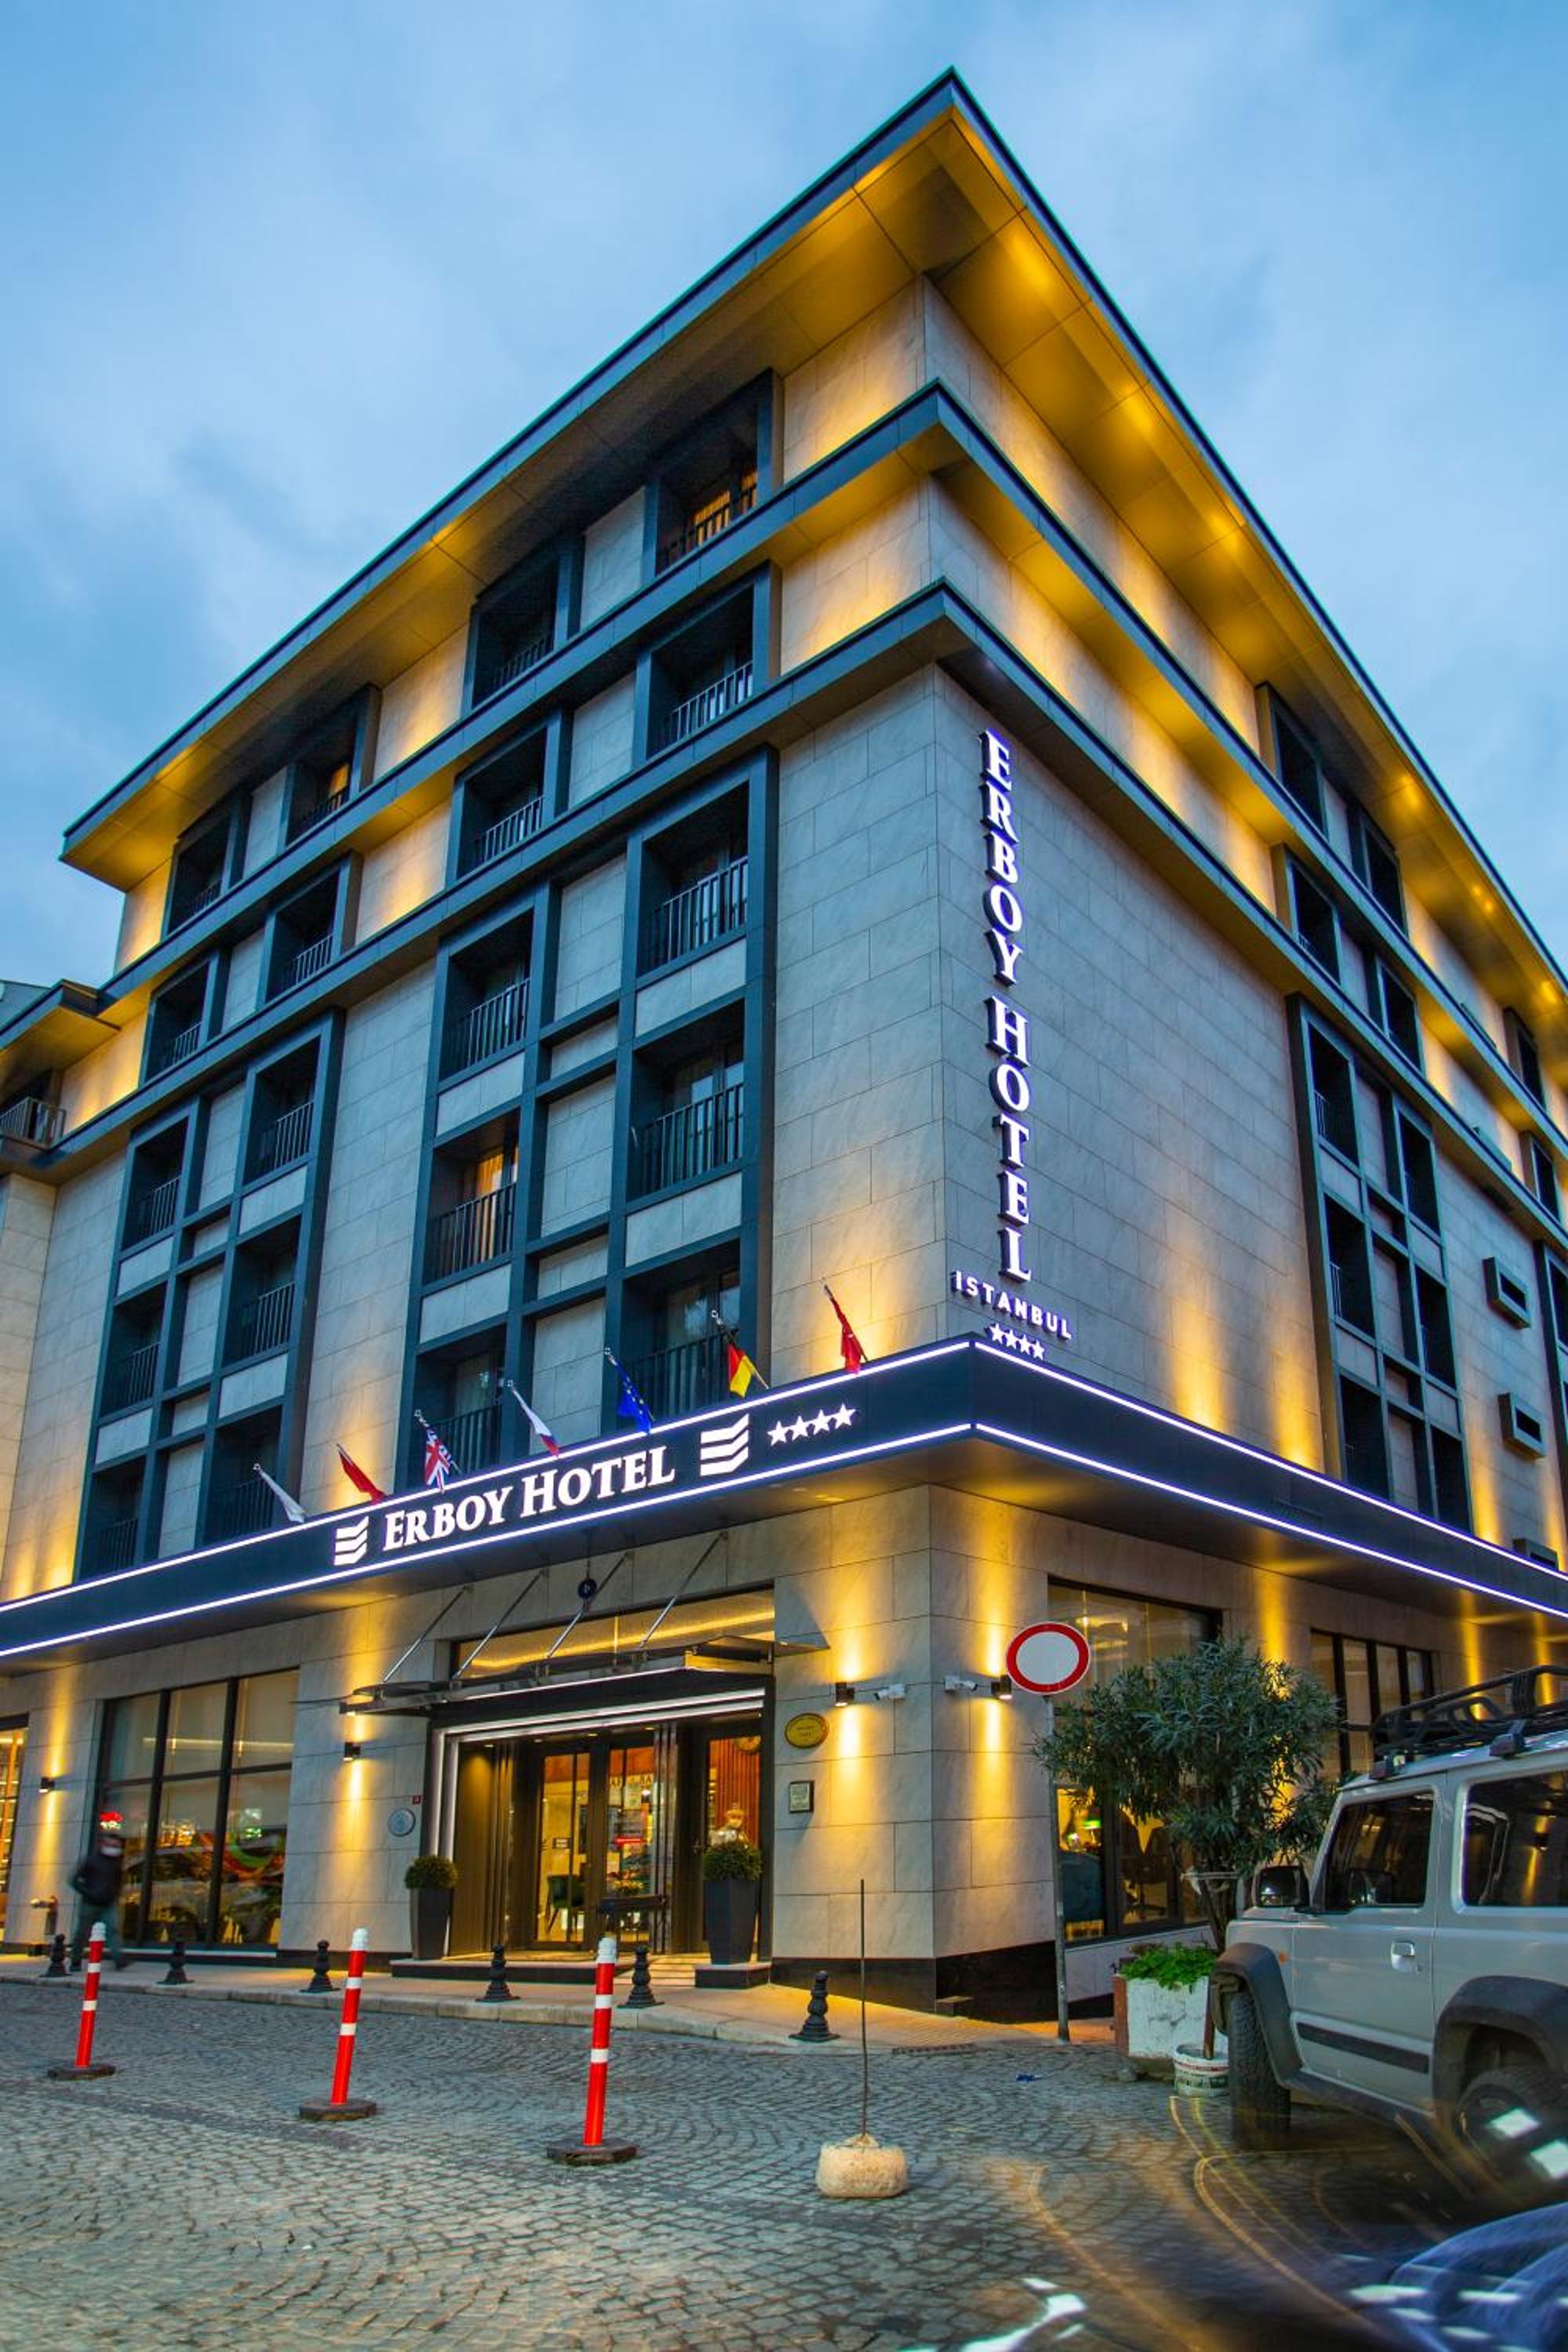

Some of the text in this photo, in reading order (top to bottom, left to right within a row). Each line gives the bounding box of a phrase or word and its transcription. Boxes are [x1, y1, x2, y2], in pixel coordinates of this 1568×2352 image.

[983, 728, 1033, 1283] ERBOY HOTEL
[954, 1269, 1073, 1341] ISTANBUL
[382, 1446, 676, 1552] ERBOY HOTEL
